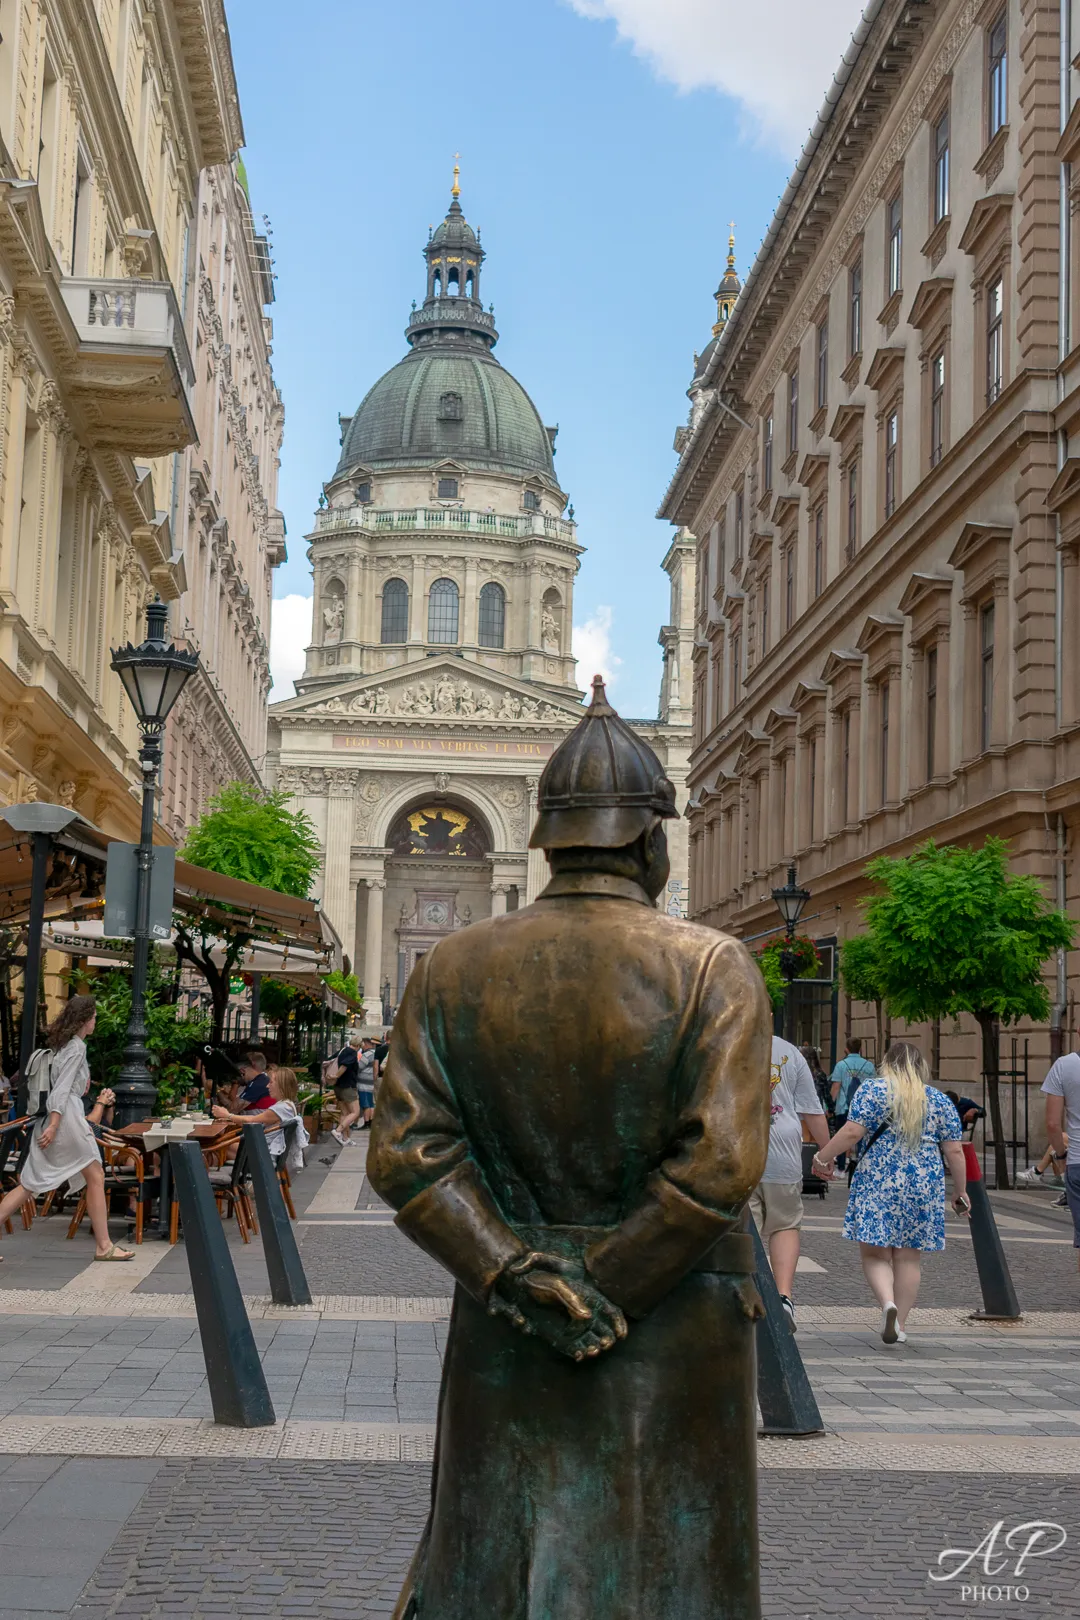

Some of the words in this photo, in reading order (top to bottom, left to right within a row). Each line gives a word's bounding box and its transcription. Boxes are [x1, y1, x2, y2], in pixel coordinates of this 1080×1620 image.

[345, 737, 370, 747] EGO
[377, 738, 404, 749] SUM
[412, 739, 432, 750] VIA
[440, 741, 488, 752] VERITAS
[495, 743, 508, 753] ET
[516, 744, 541, 755] VITA
[54, 935, 90, 947] BEST
